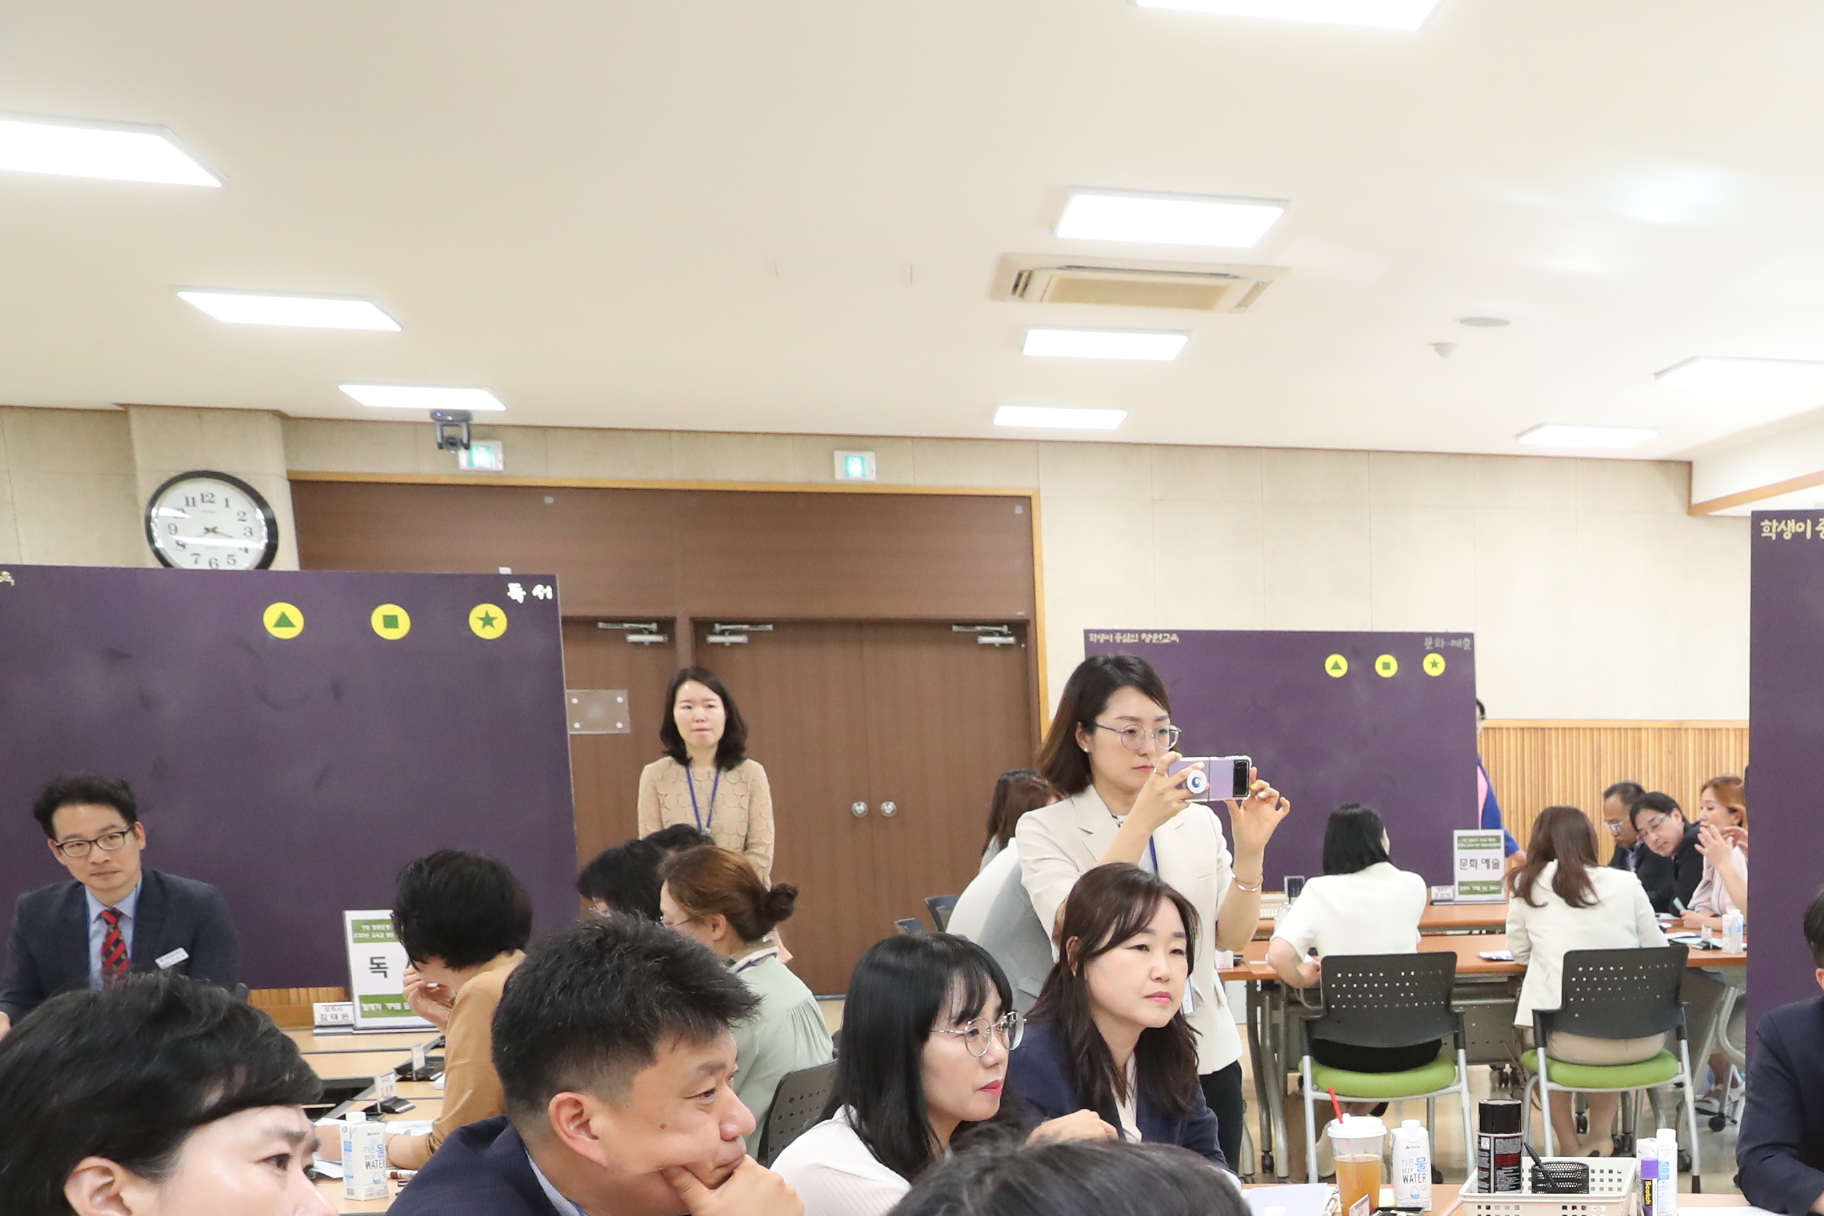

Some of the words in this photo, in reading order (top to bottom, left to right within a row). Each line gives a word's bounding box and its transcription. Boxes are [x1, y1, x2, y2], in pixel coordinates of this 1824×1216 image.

[185, 496, 197, 507] 11
[200, 492, 215, 504] 12
[224, 498, 230, 508] 1
[237, 510, 246, 522] 2
[167, 523, 178, 535] 9
[243, 526, 253, 538] 3
[1760, 518, 1812, 540] 학생이
[175, 540, 186, 551] 8
[191, 553, 201, 565] 7
[208, 557, 219, 569] 6
[226, 554, 237, 565] 5
[1415, 1157, 1427, 1172] 물
[1402, 1173, 1427, 1184] WATER
[1644, 1180, 1652, 1205] Scotch
